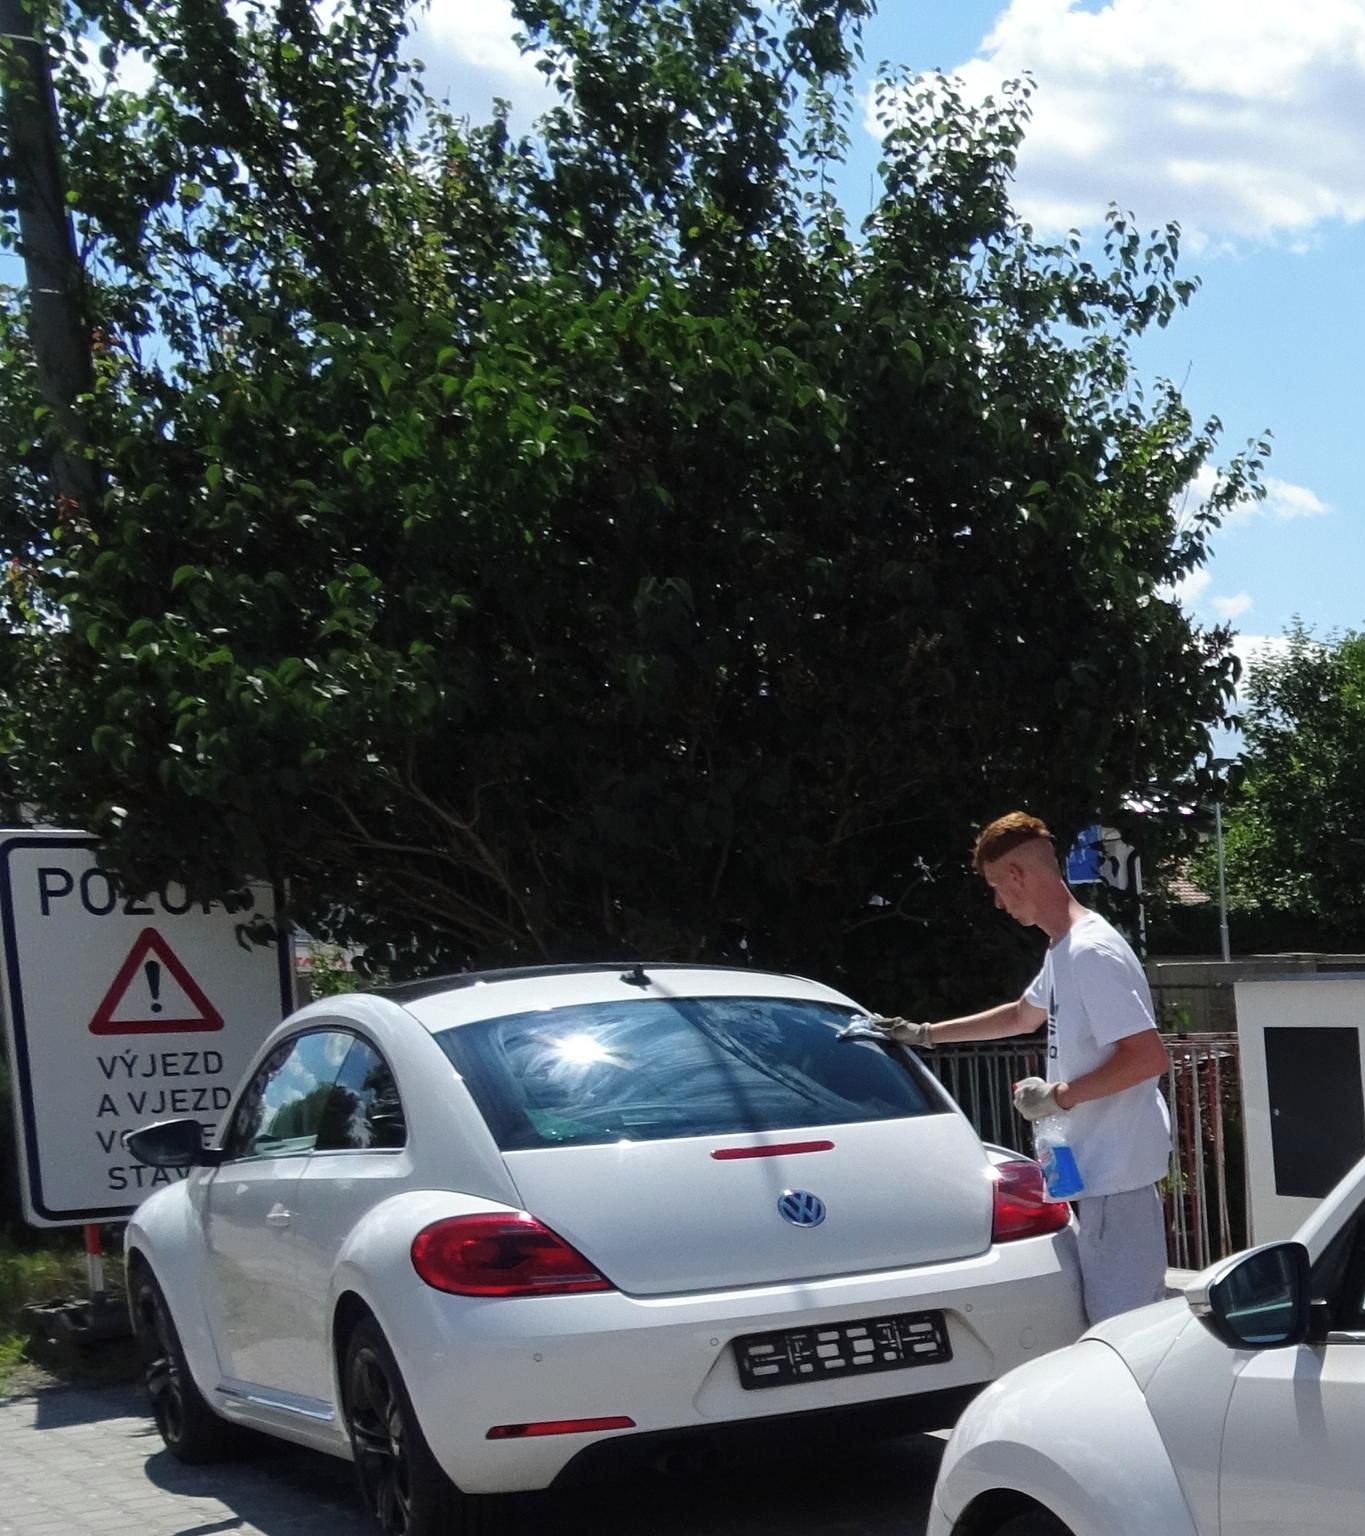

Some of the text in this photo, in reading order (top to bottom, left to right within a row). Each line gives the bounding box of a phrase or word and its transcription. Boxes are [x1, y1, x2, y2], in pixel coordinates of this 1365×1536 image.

[37, 866, 241, 917] POO
[96, 1048, 224, 1080] VÝJEZD
[96, 1086, 232, 1118] A VJEZD
[108, 1163, 192, 1191] STAV
